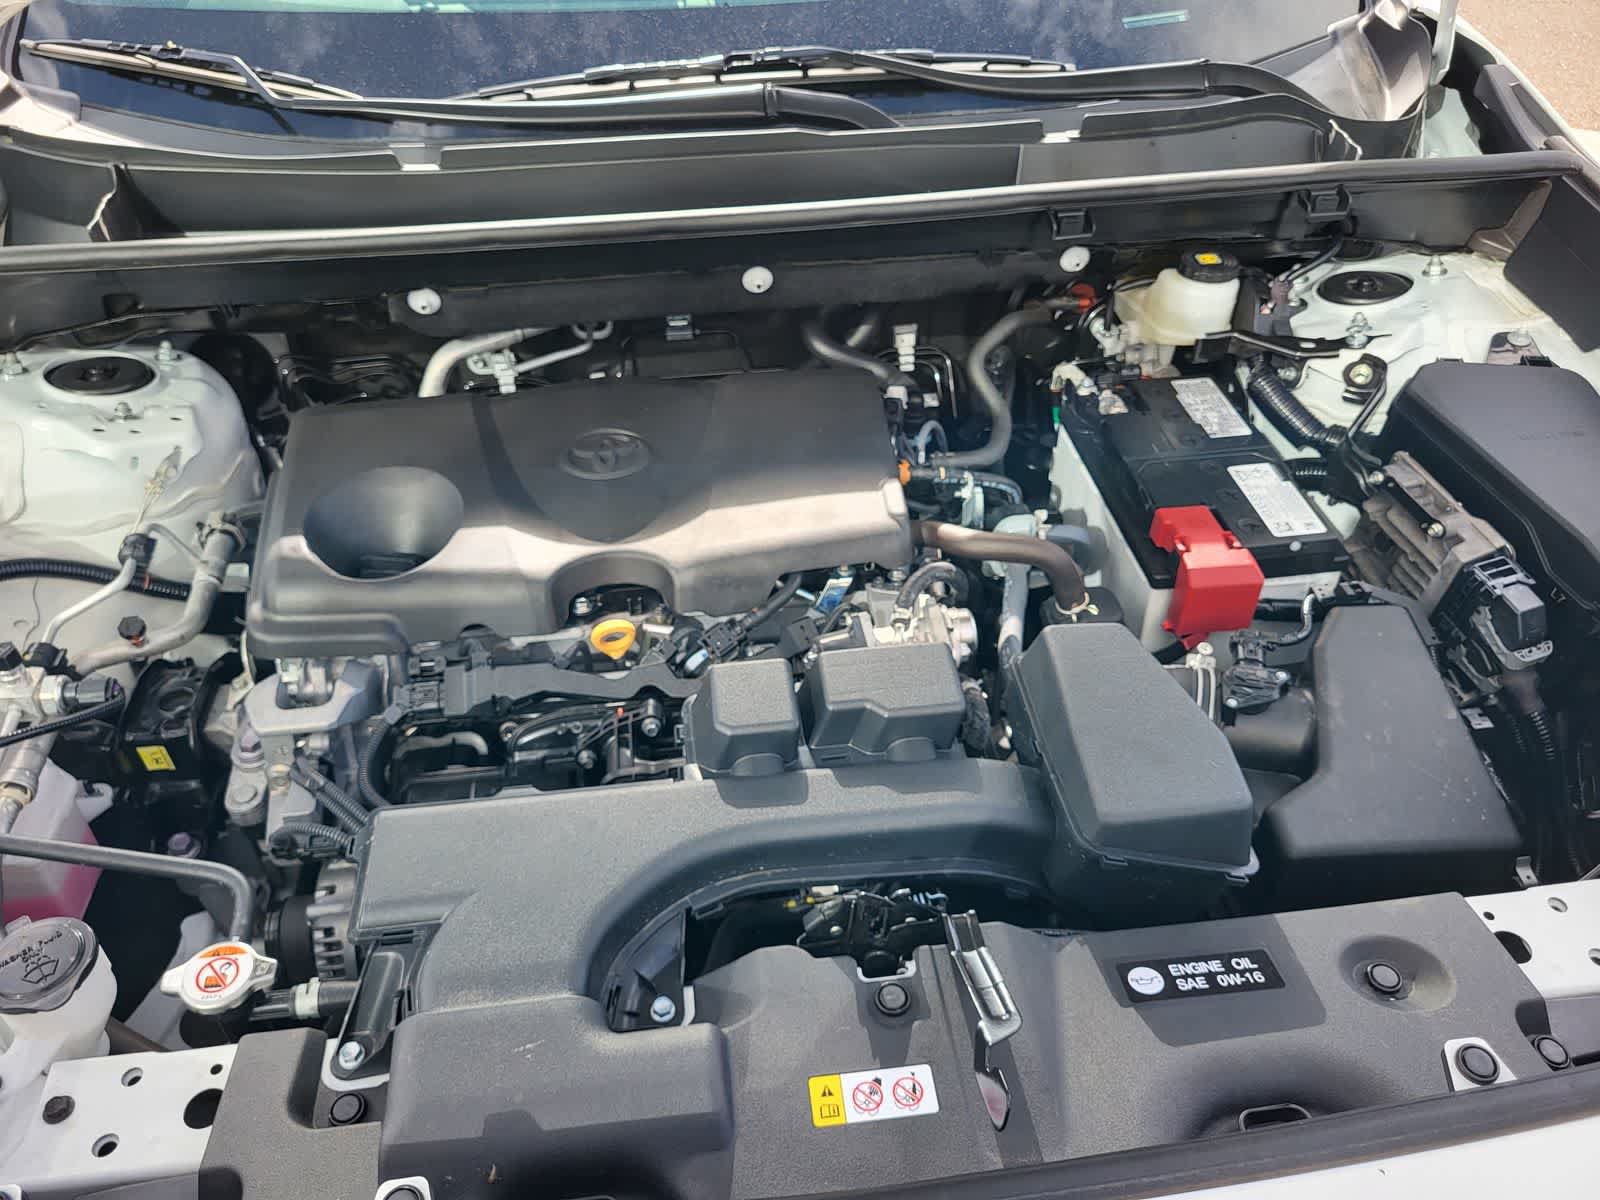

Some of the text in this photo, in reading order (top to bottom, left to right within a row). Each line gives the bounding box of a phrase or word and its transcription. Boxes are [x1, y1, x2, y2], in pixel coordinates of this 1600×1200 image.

[1167, 957, 1259, 977] ENGINE OIL
[1175, 971, 1266, 991] SAE 0W-16
